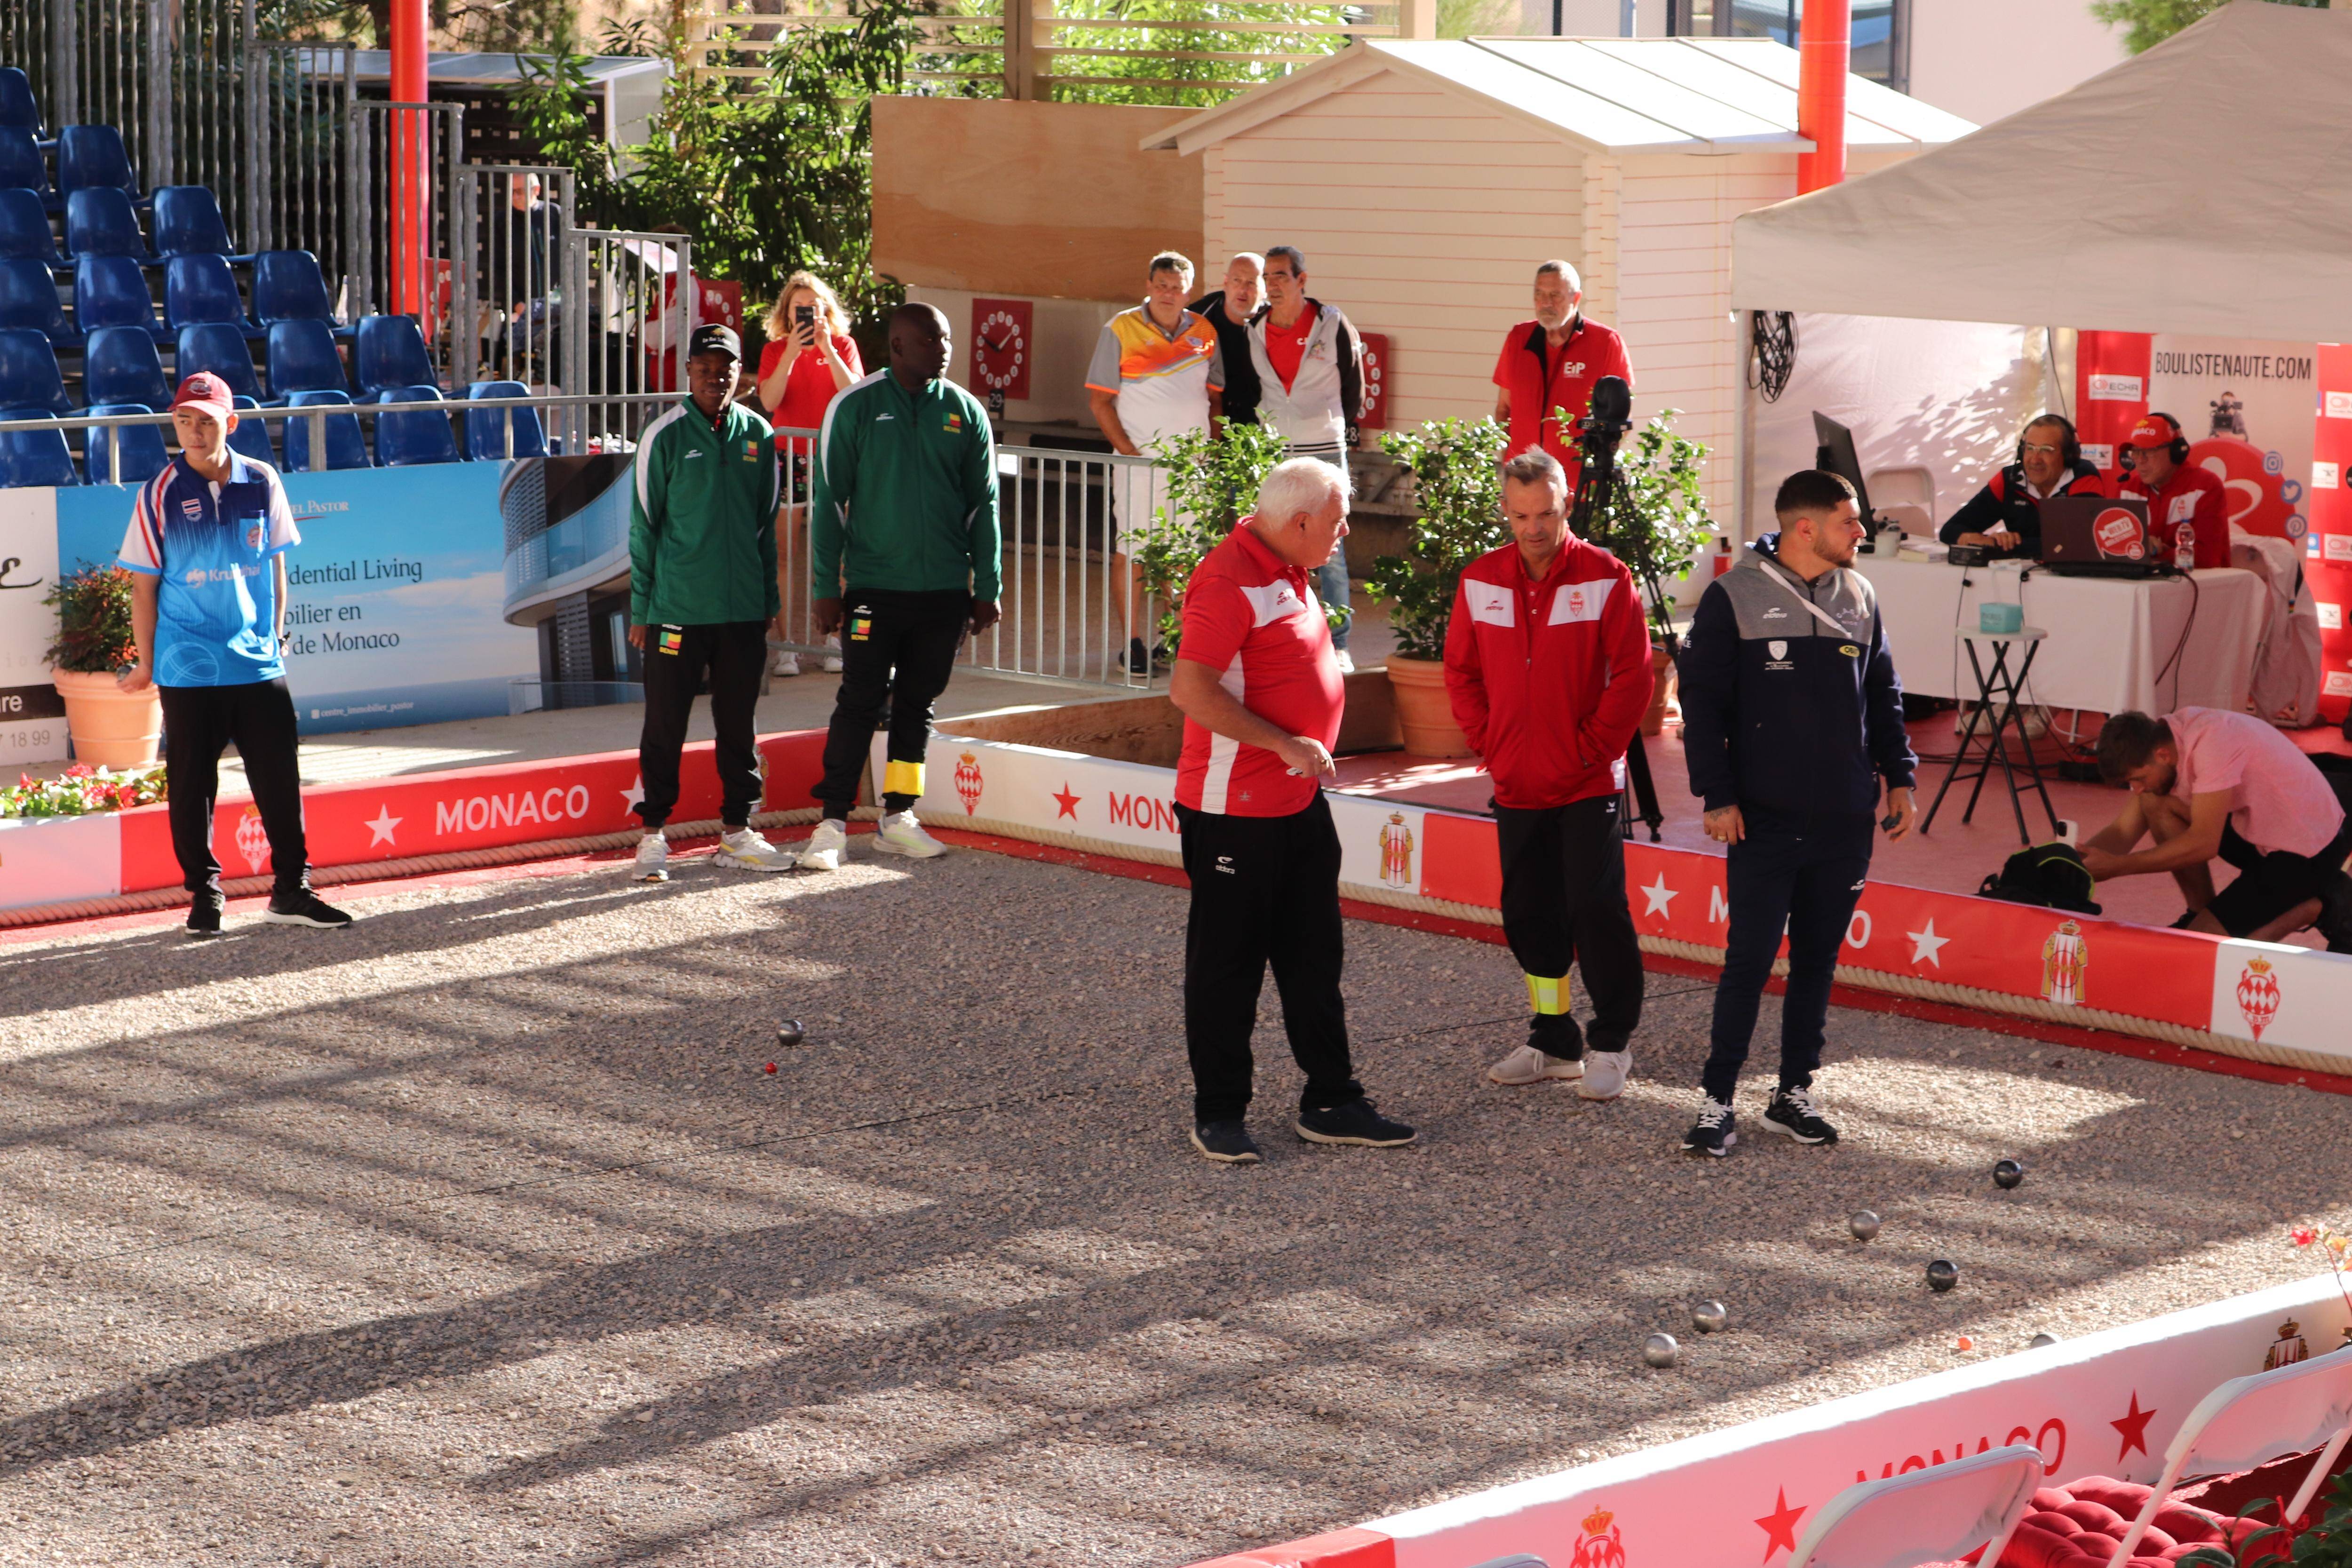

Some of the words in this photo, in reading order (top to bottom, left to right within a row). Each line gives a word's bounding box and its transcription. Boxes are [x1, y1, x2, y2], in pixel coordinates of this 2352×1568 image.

[2156, 352, 2311, 379] BOULISTENAUTE.COM
[990, 393, 1002, 407] 29
[364, 558, 422, 583] Living
[338, 605, 361, 621] en
[293, 635, 316, 655] de
[322, 632, 399, 653] Monaco
[0, 695, 23, 713] re
[10, 732, 27, 748] 18
[32, 730, 50, 746] 99
[436, 785, 589, 836] MONACO
